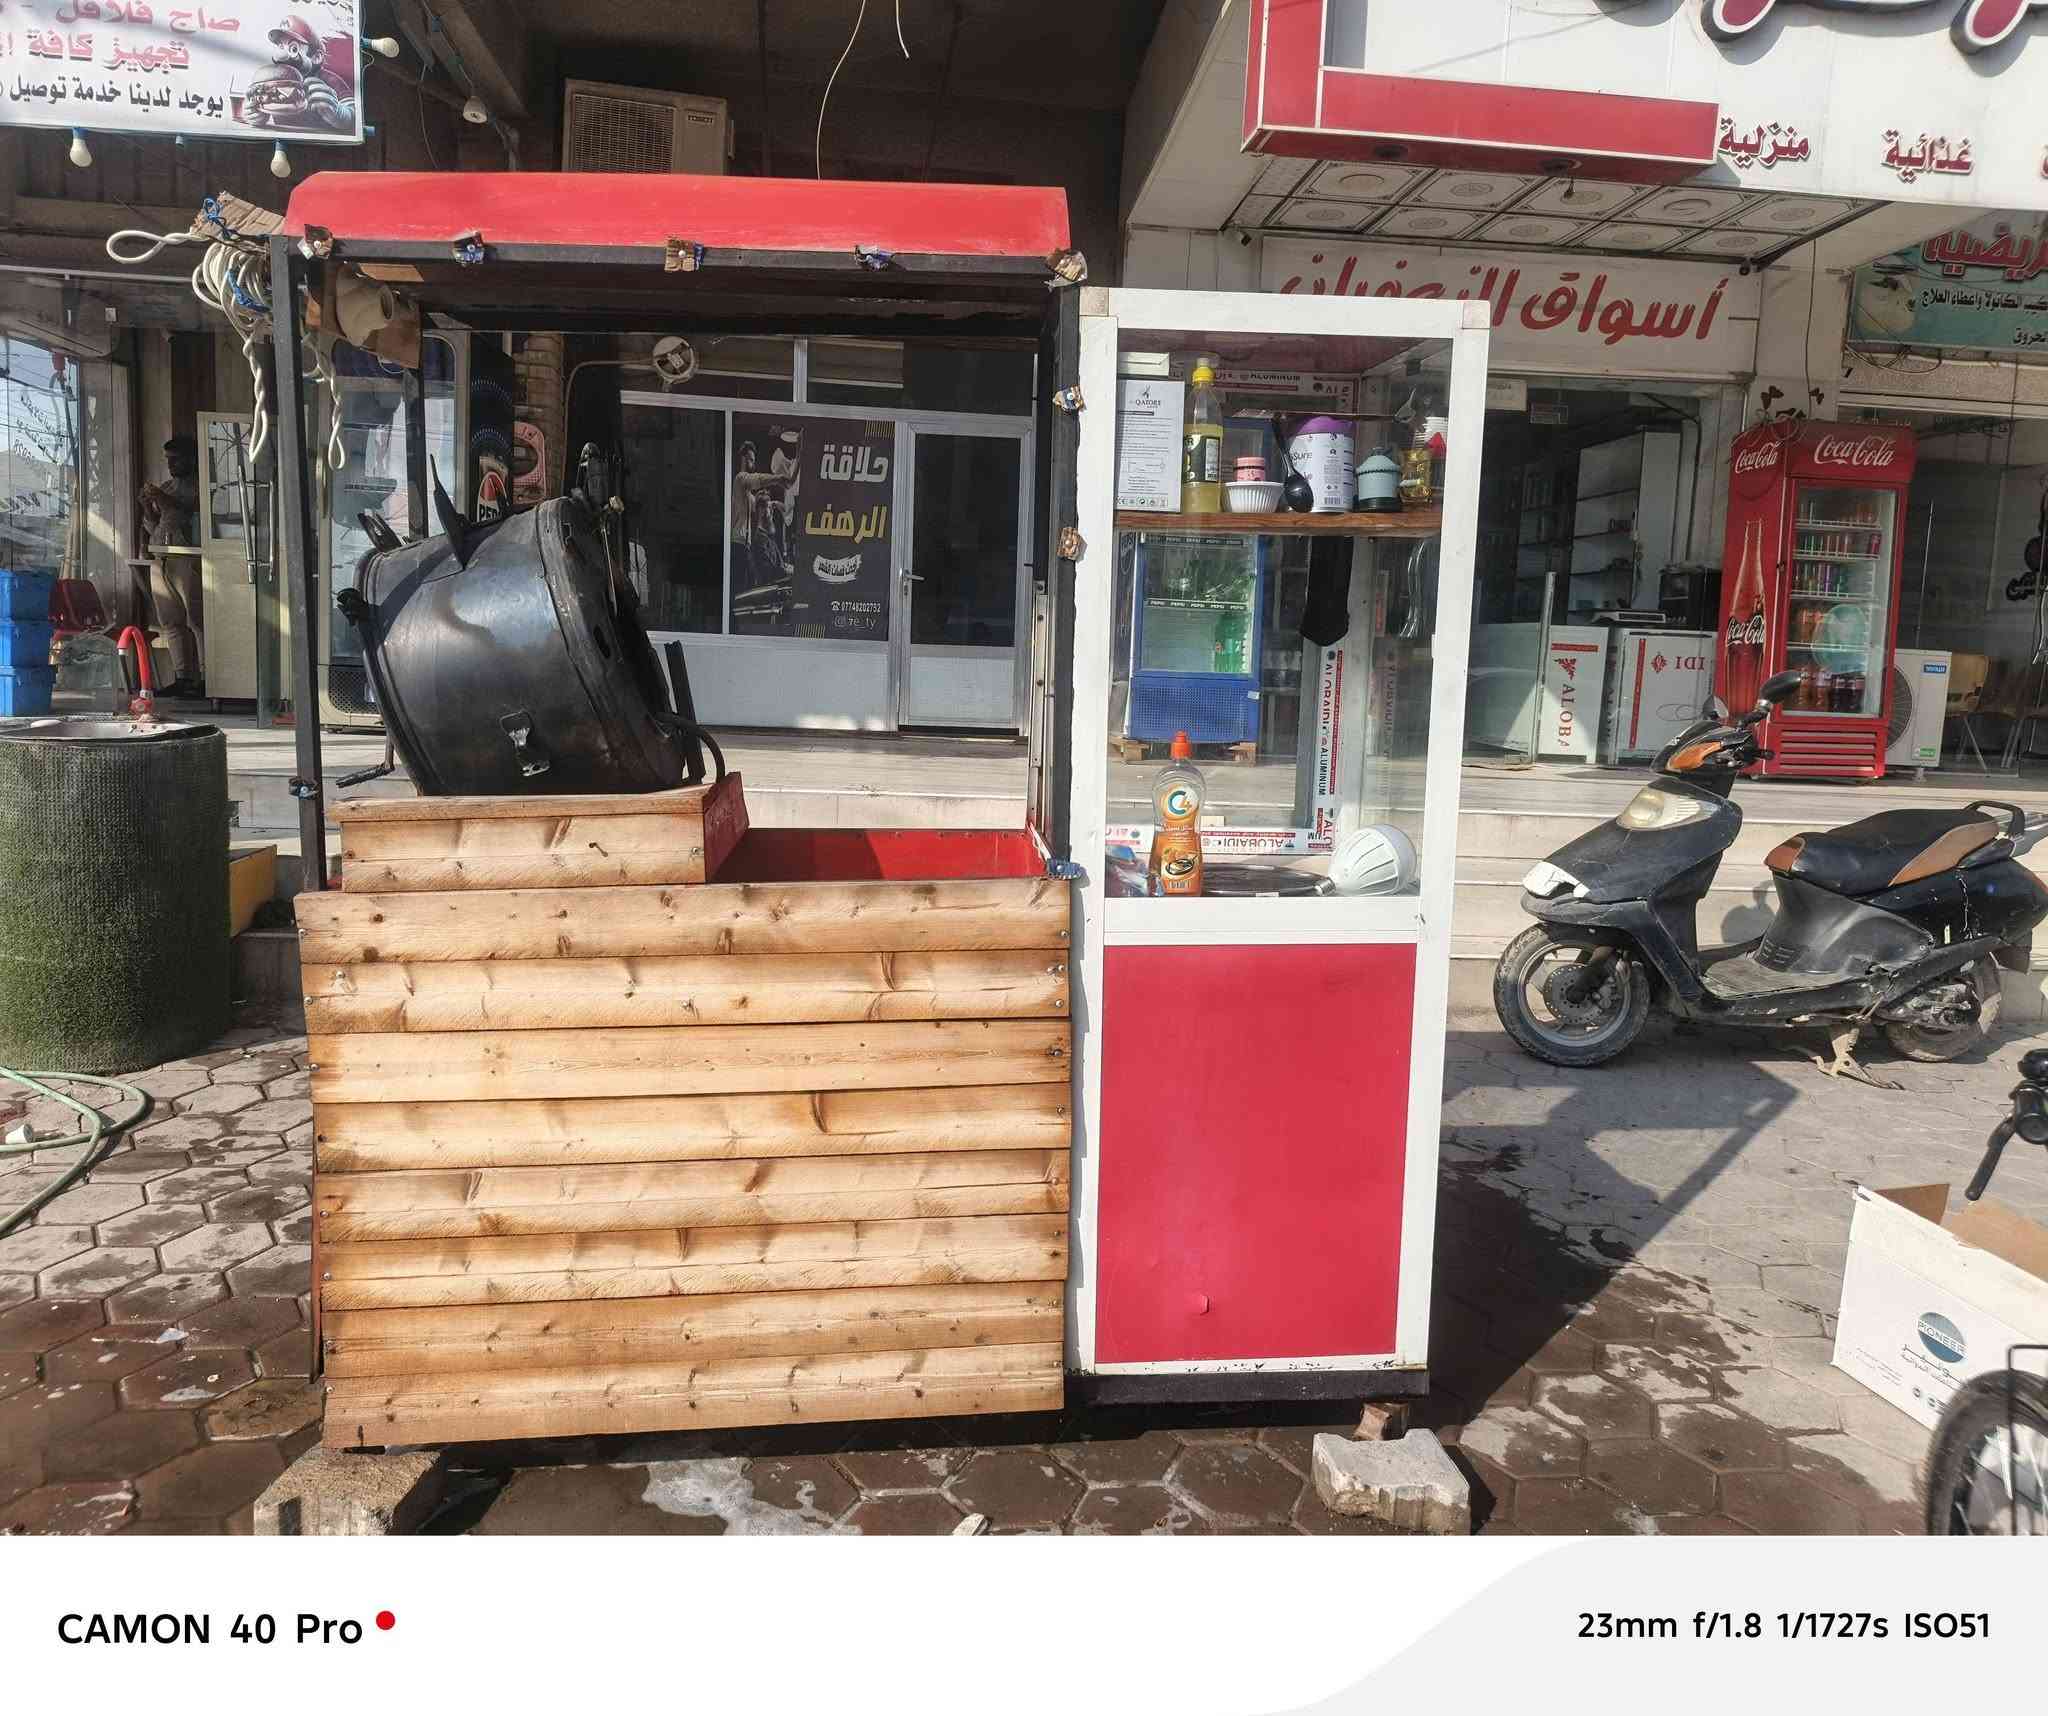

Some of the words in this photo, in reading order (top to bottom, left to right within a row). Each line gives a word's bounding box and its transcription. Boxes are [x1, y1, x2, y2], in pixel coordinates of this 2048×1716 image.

[168, 7, 240, 34] صاج
[27, 29, 93, 61] كافة
[103, 37, 190, 74] تجهيز
[9, 72, 67, 104] توصيل
[72, 76, 121, 103] خدمة
[129, 81, 171, 113] لدينا
[178, 89, 224, 119] يوجد
[1719, 116, 1811, 169] منزلية
[1881, 128, 1975, 183] غذائية
[1519, 270, 1730, 346] أسواق
[820, 443, 889, 483] حلاقة
[1814, 434, 1896, 467] Coca-Cola
[804, 503, 888, 545] الرهف
